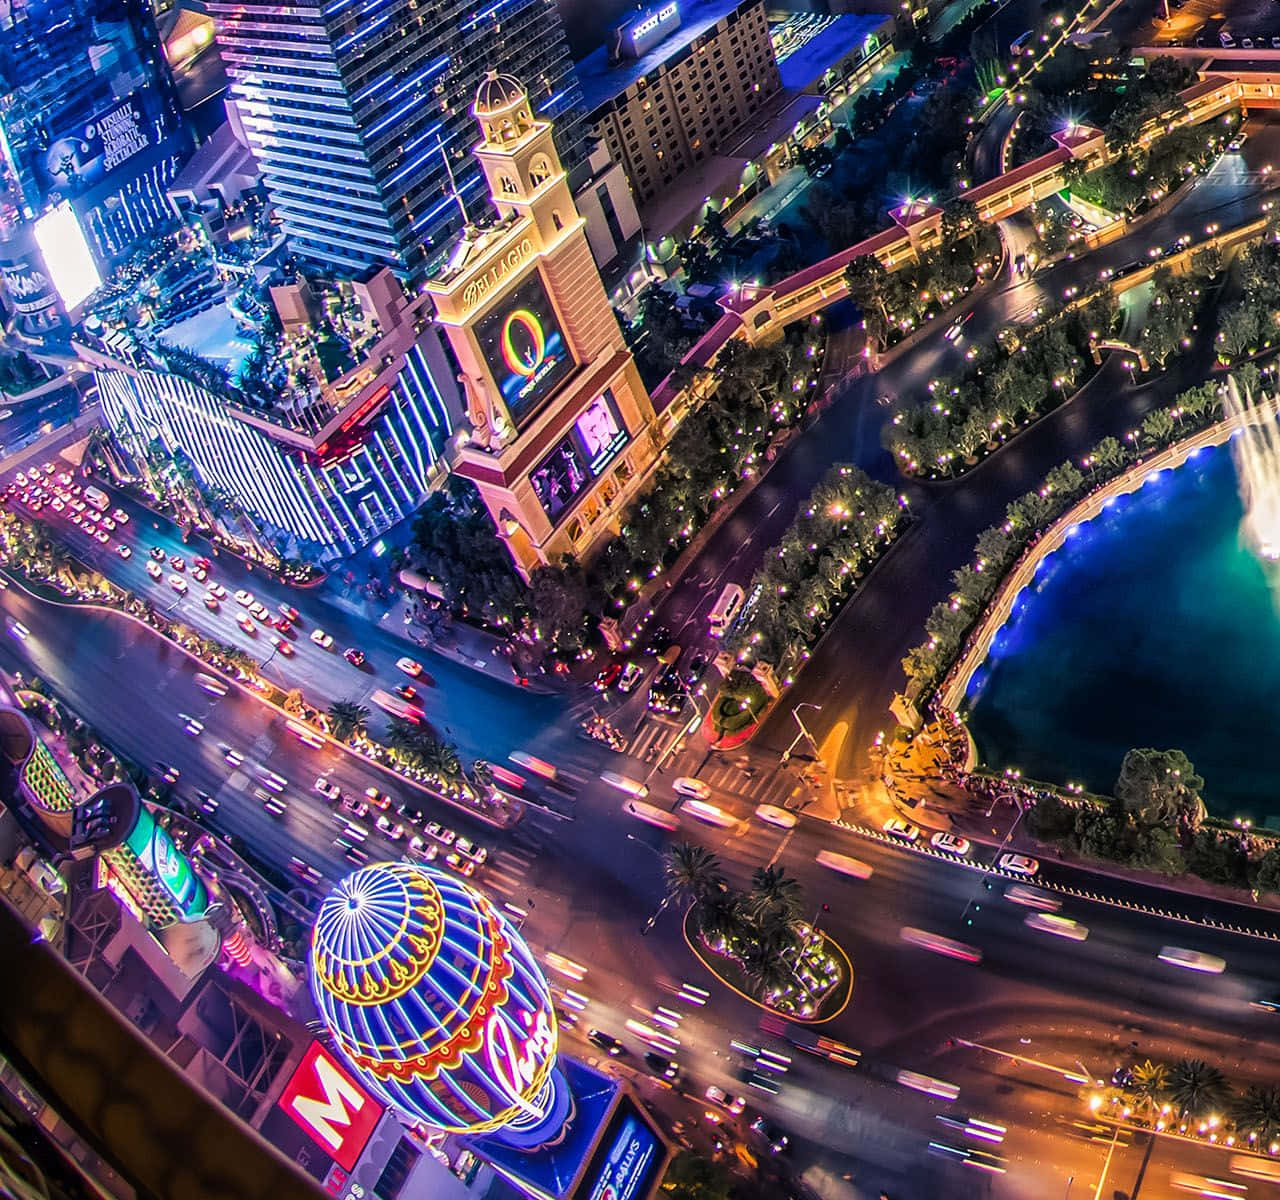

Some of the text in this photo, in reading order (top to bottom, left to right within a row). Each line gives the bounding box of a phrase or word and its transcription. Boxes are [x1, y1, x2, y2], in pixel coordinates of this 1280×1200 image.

[463, 238, 532, 312] BELLAGIO
[291, 1054, 366, 1151] M
[486, 1010, 554, 1119] Paris
